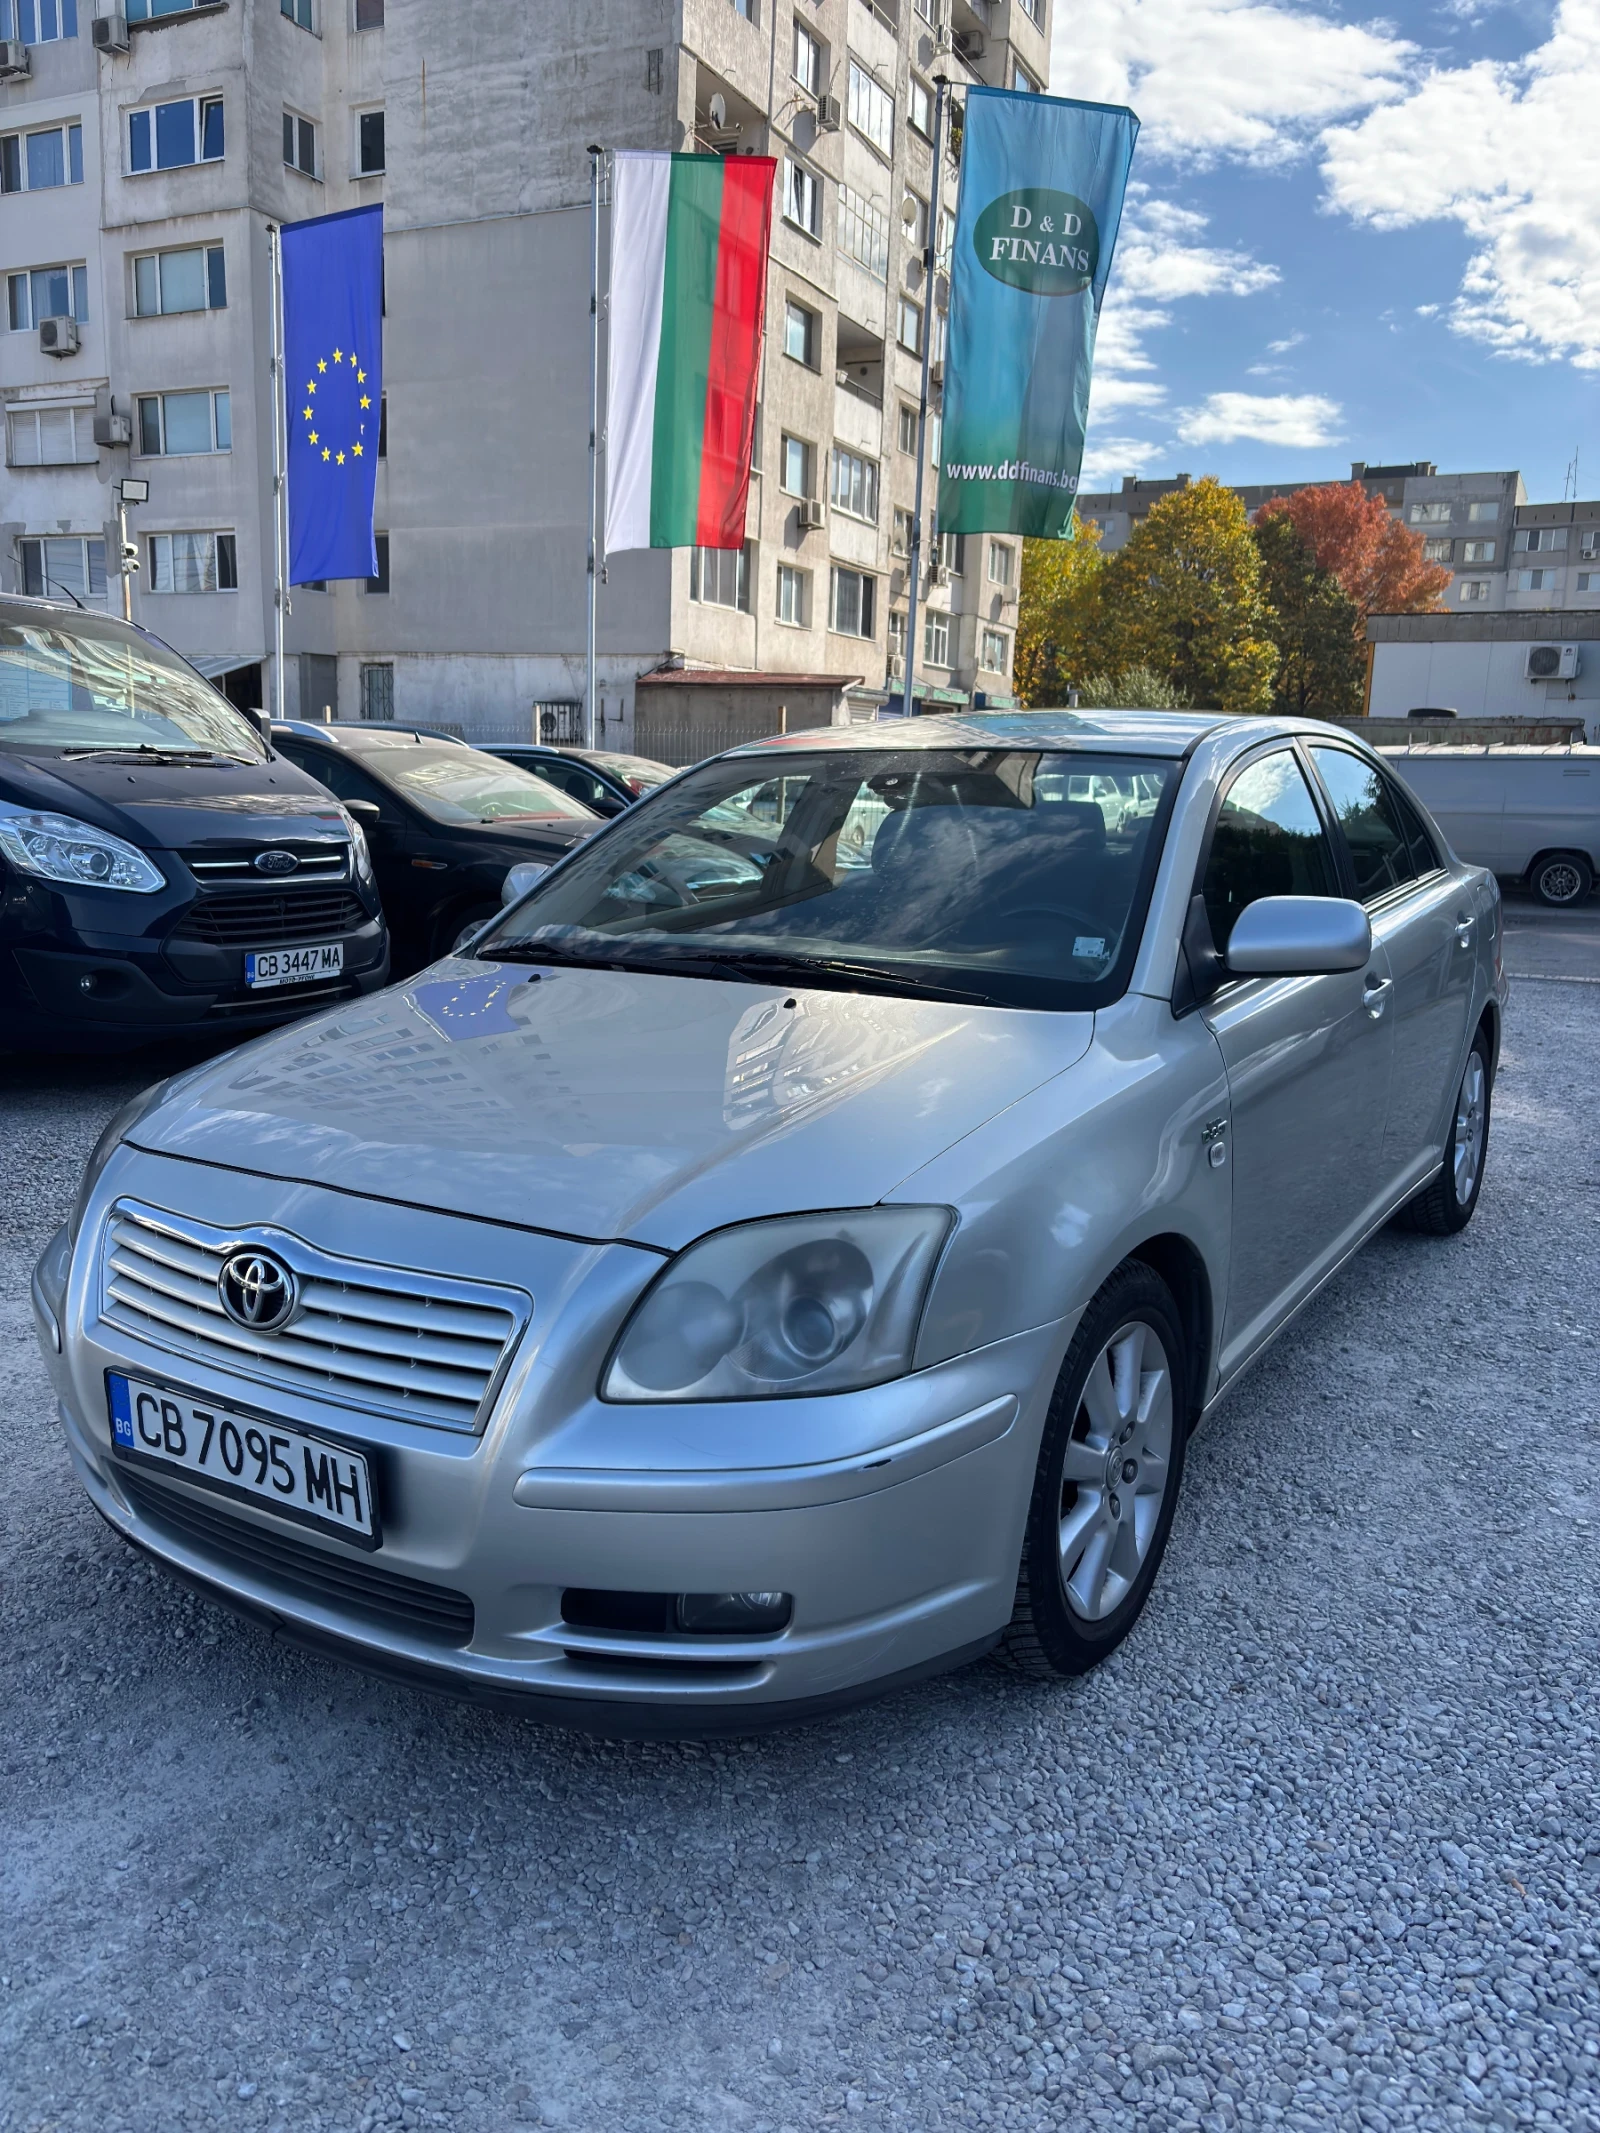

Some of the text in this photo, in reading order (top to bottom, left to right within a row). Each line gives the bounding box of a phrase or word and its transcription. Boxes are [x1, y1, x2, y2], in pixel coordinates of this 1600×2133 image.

[1010, 205, 1082, 236] D & D
[989, 237, 1090, 272] FINANS
[946, 460, 1079, 495] www.ddfinans.bg
[258, 947, 340, 977] CB 3447 MA
[115, 1417, 131, 1437] BG
[136, 1392, 364, 1524] CB 7095 MH
